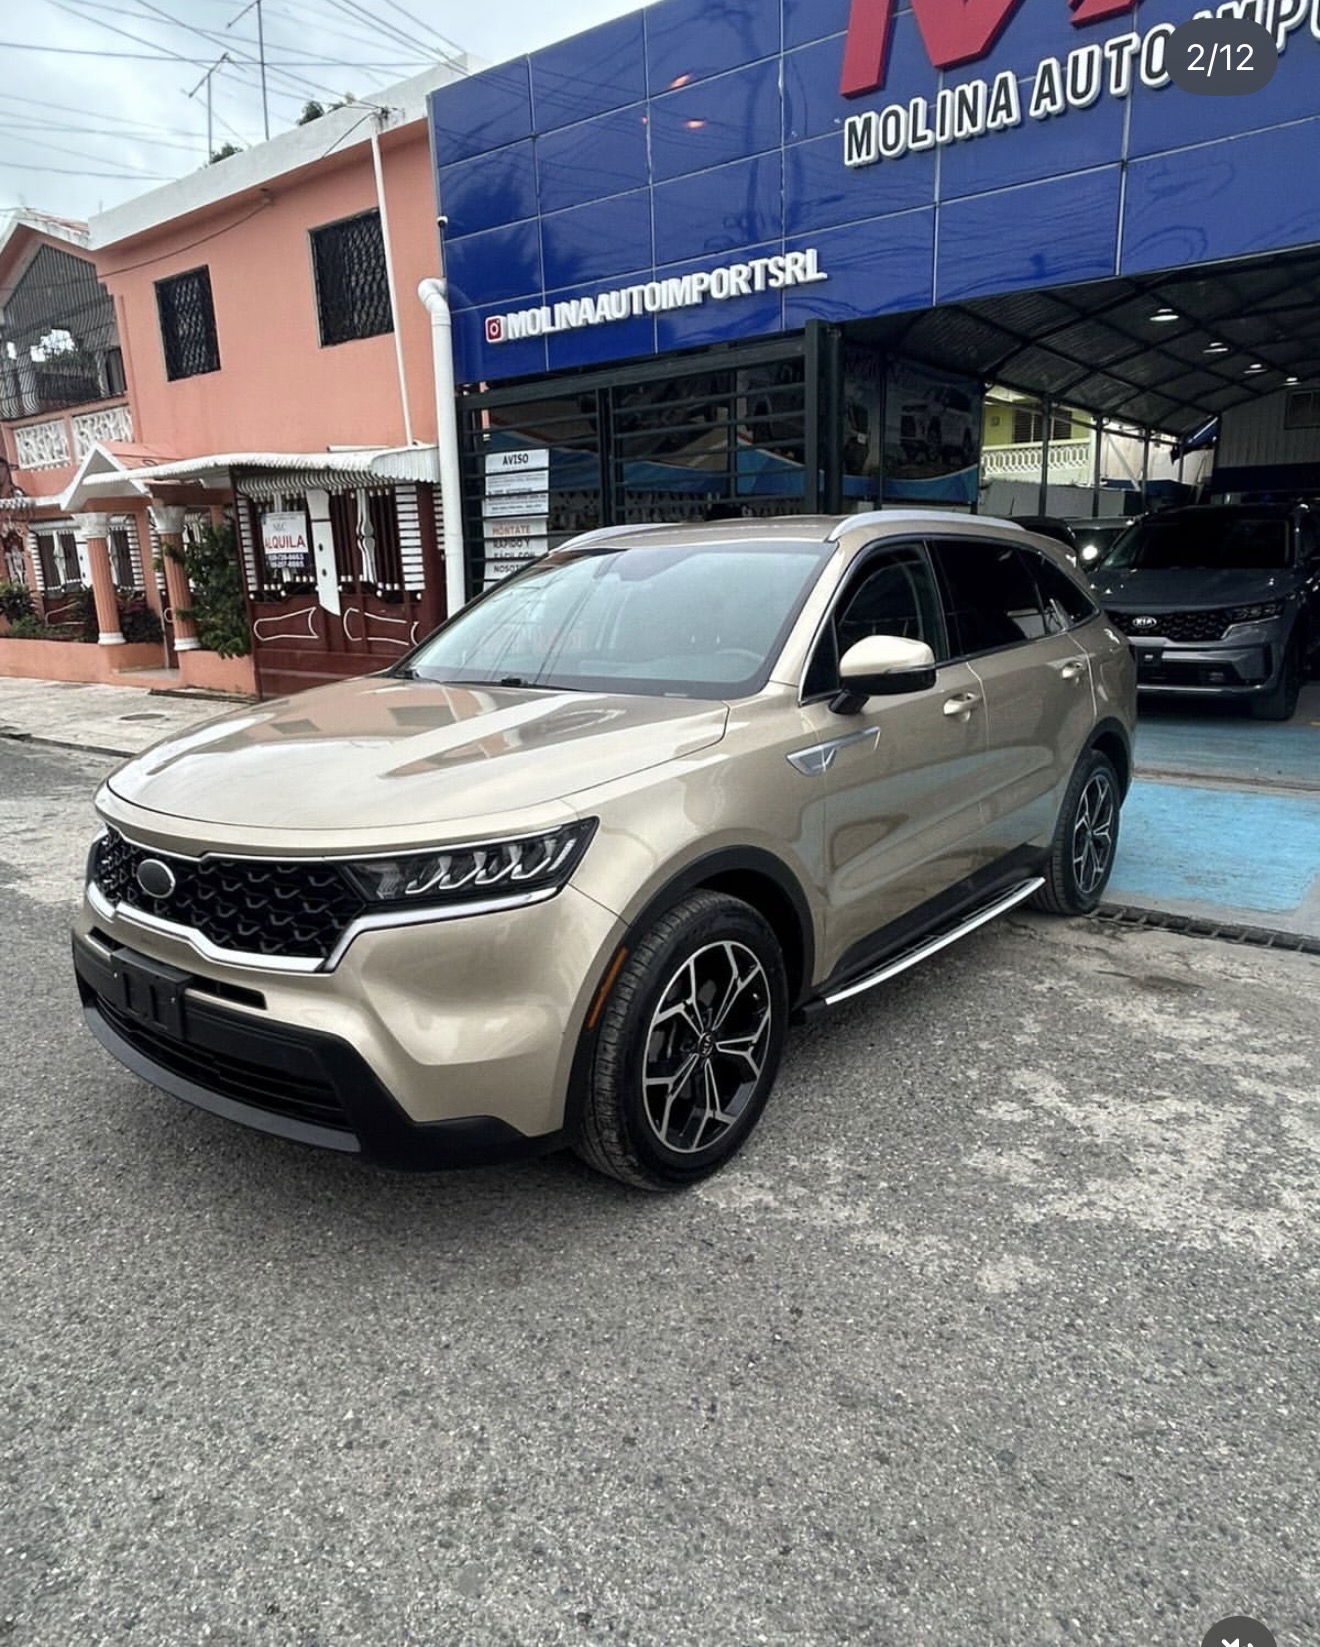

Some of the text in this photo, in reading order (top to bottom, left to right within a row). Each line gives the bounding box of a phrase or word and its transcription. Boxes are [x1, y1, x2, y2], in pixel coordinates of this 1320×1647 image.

[843, 70, 1022, 167] MOLINA
[1029, 22, 1176, 120] AUTO
[505, 248, 828, 341] MOLINAAUTOIMPORTSRL
[502, 453, 529, 466] AVISO
[1133, 616, 1157, 628] KIA
